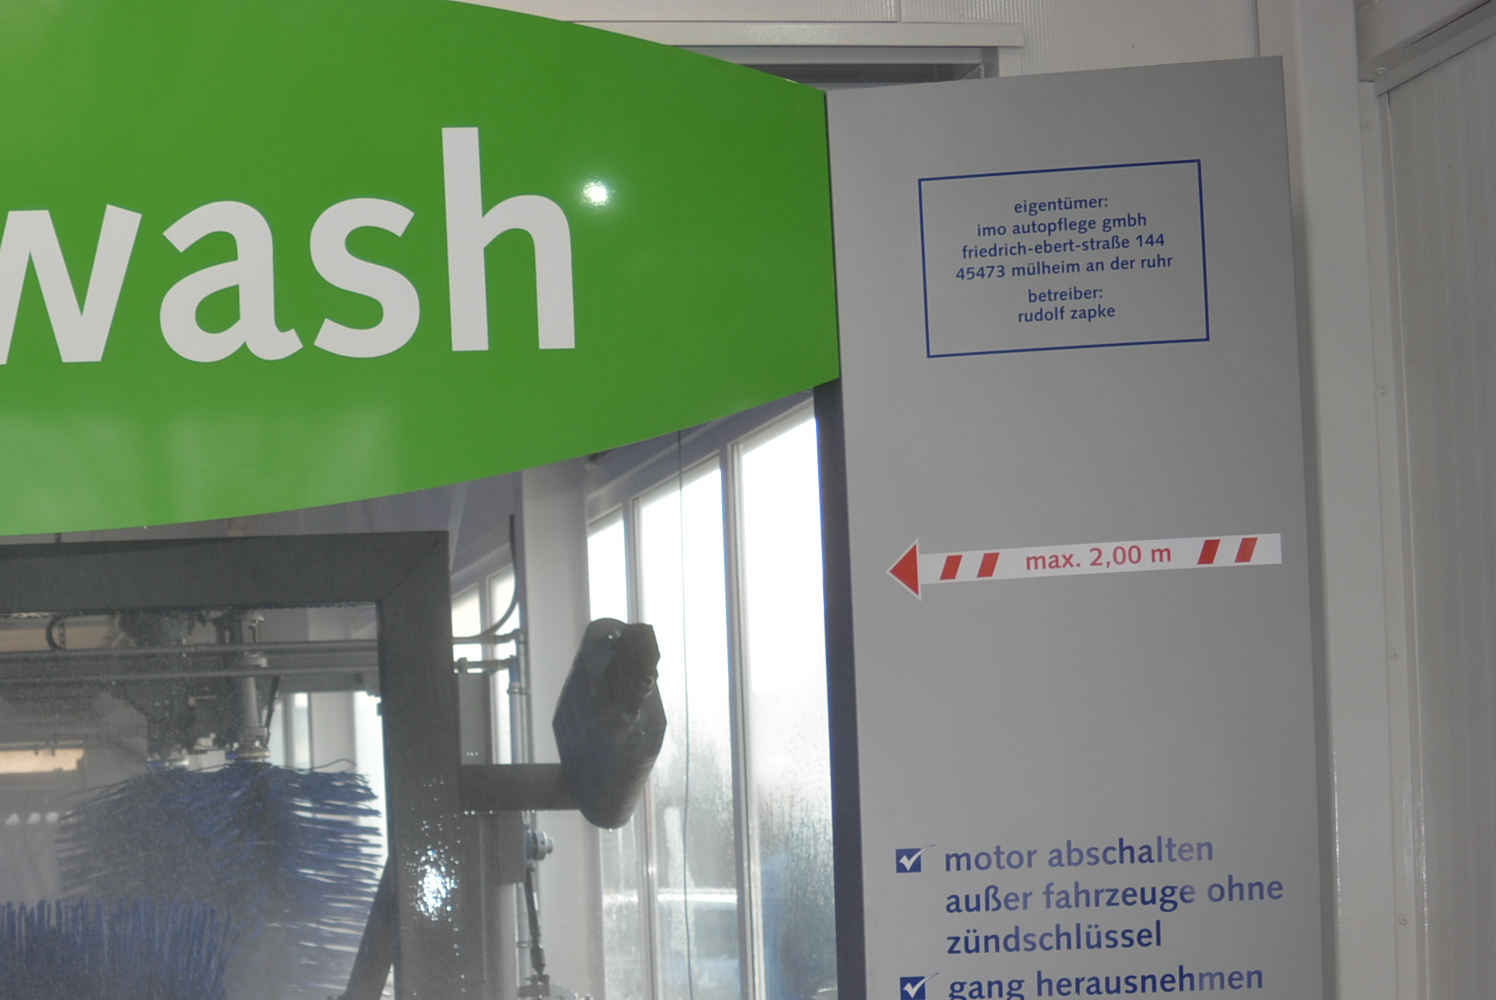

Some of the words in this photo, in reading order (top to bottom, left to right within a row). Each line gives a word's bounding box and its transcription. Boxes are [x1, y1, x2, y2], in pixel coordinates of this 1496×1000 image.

[1013, 196, 1109, 216] eigentümer:
[977, 223, 1007, 238] imo
[1012, 217, 1097, 236] autopflege
[1101, 212, 1147, 232] gmbh
[961, 235, 1130, 260] friedrich-ebert-straße
[1135, 233, 1165, 248] 144
[955, 264, 1006, 281] 45473
[1011, 259, 1081, 278] mülheim
[1086, 258, 1105, 272] an
[1110, 254, 1136, 270] der
[1140, 253, 1174, 269] ruhr
[1027, 286, 1103, 303] betreiber:
[1018, 305, 1065, 322] rudolf
[1070, 303, 1116, 323] zapke
[1025, 552, 1081, 571] max.
[1089, 545, 1142, 569] 2,00
[1150, 547, 1172, 563] m
[944, 845, 1038, 872] motor
[1047, 836, 1214, 868] abschalten
[945, 885, 1033, 914] außer
[1043, 881, 1196, 913] fahrzeuge
[1206, 874, 1284, 903] ohne
[946, 919, 1162, 955] zündschlüssel
[1036, 965, 1264, 997] herausnehmen
